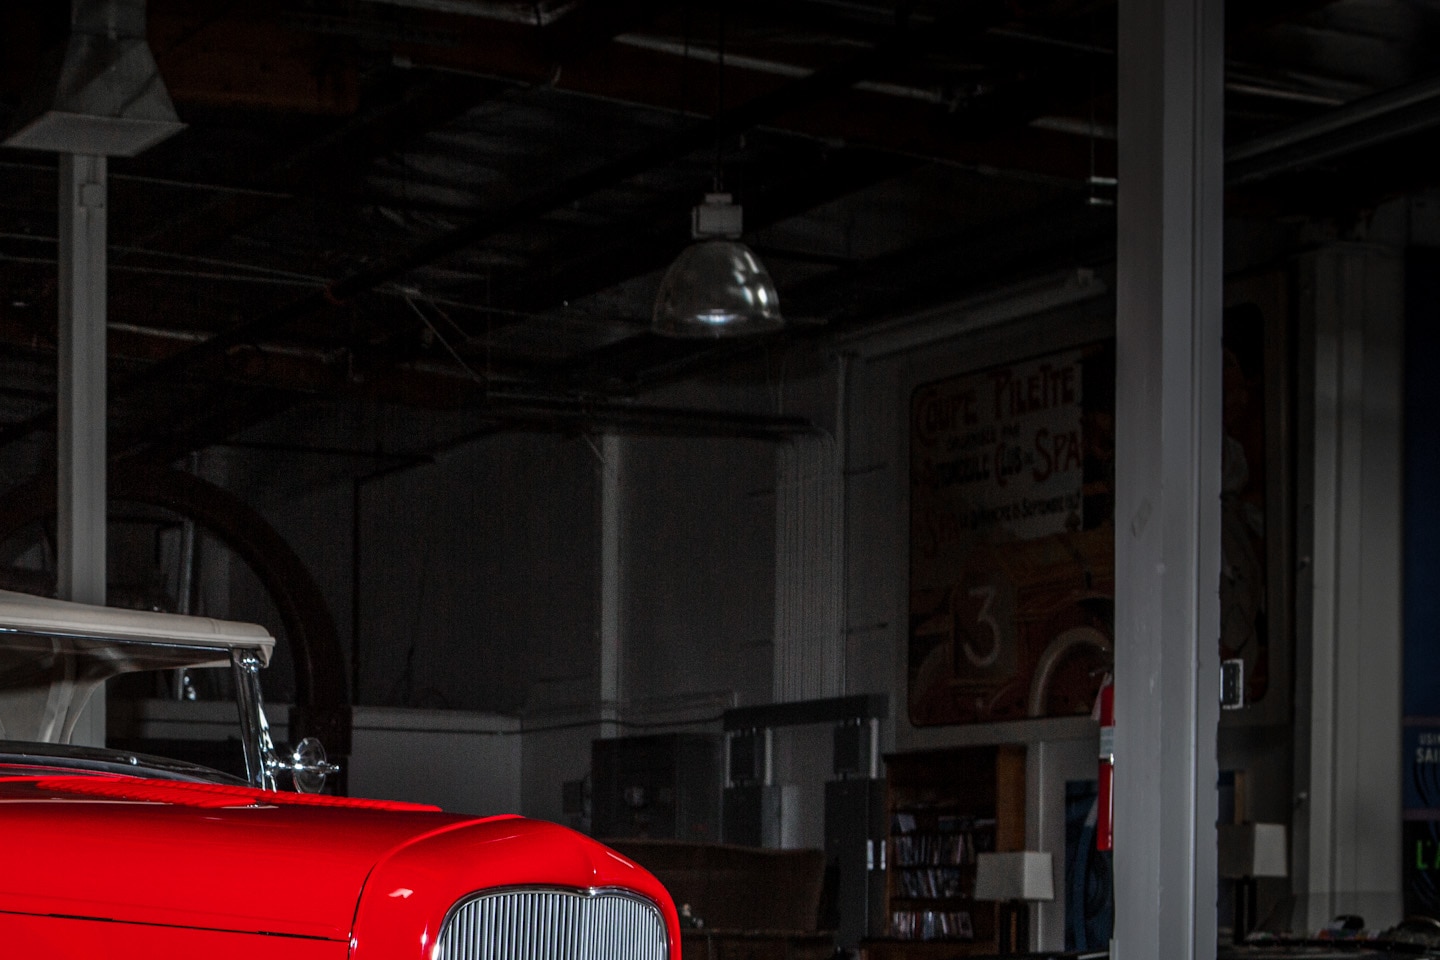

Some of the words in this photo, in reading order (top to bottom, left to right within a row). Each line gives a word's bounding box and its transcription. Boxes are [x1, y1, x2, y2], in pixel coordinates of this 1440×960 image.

[988, 364, 1074, 419] PILETTE
[1033, 428, 1082, 481] SPA
[962, 585, 1001, 667] 3
